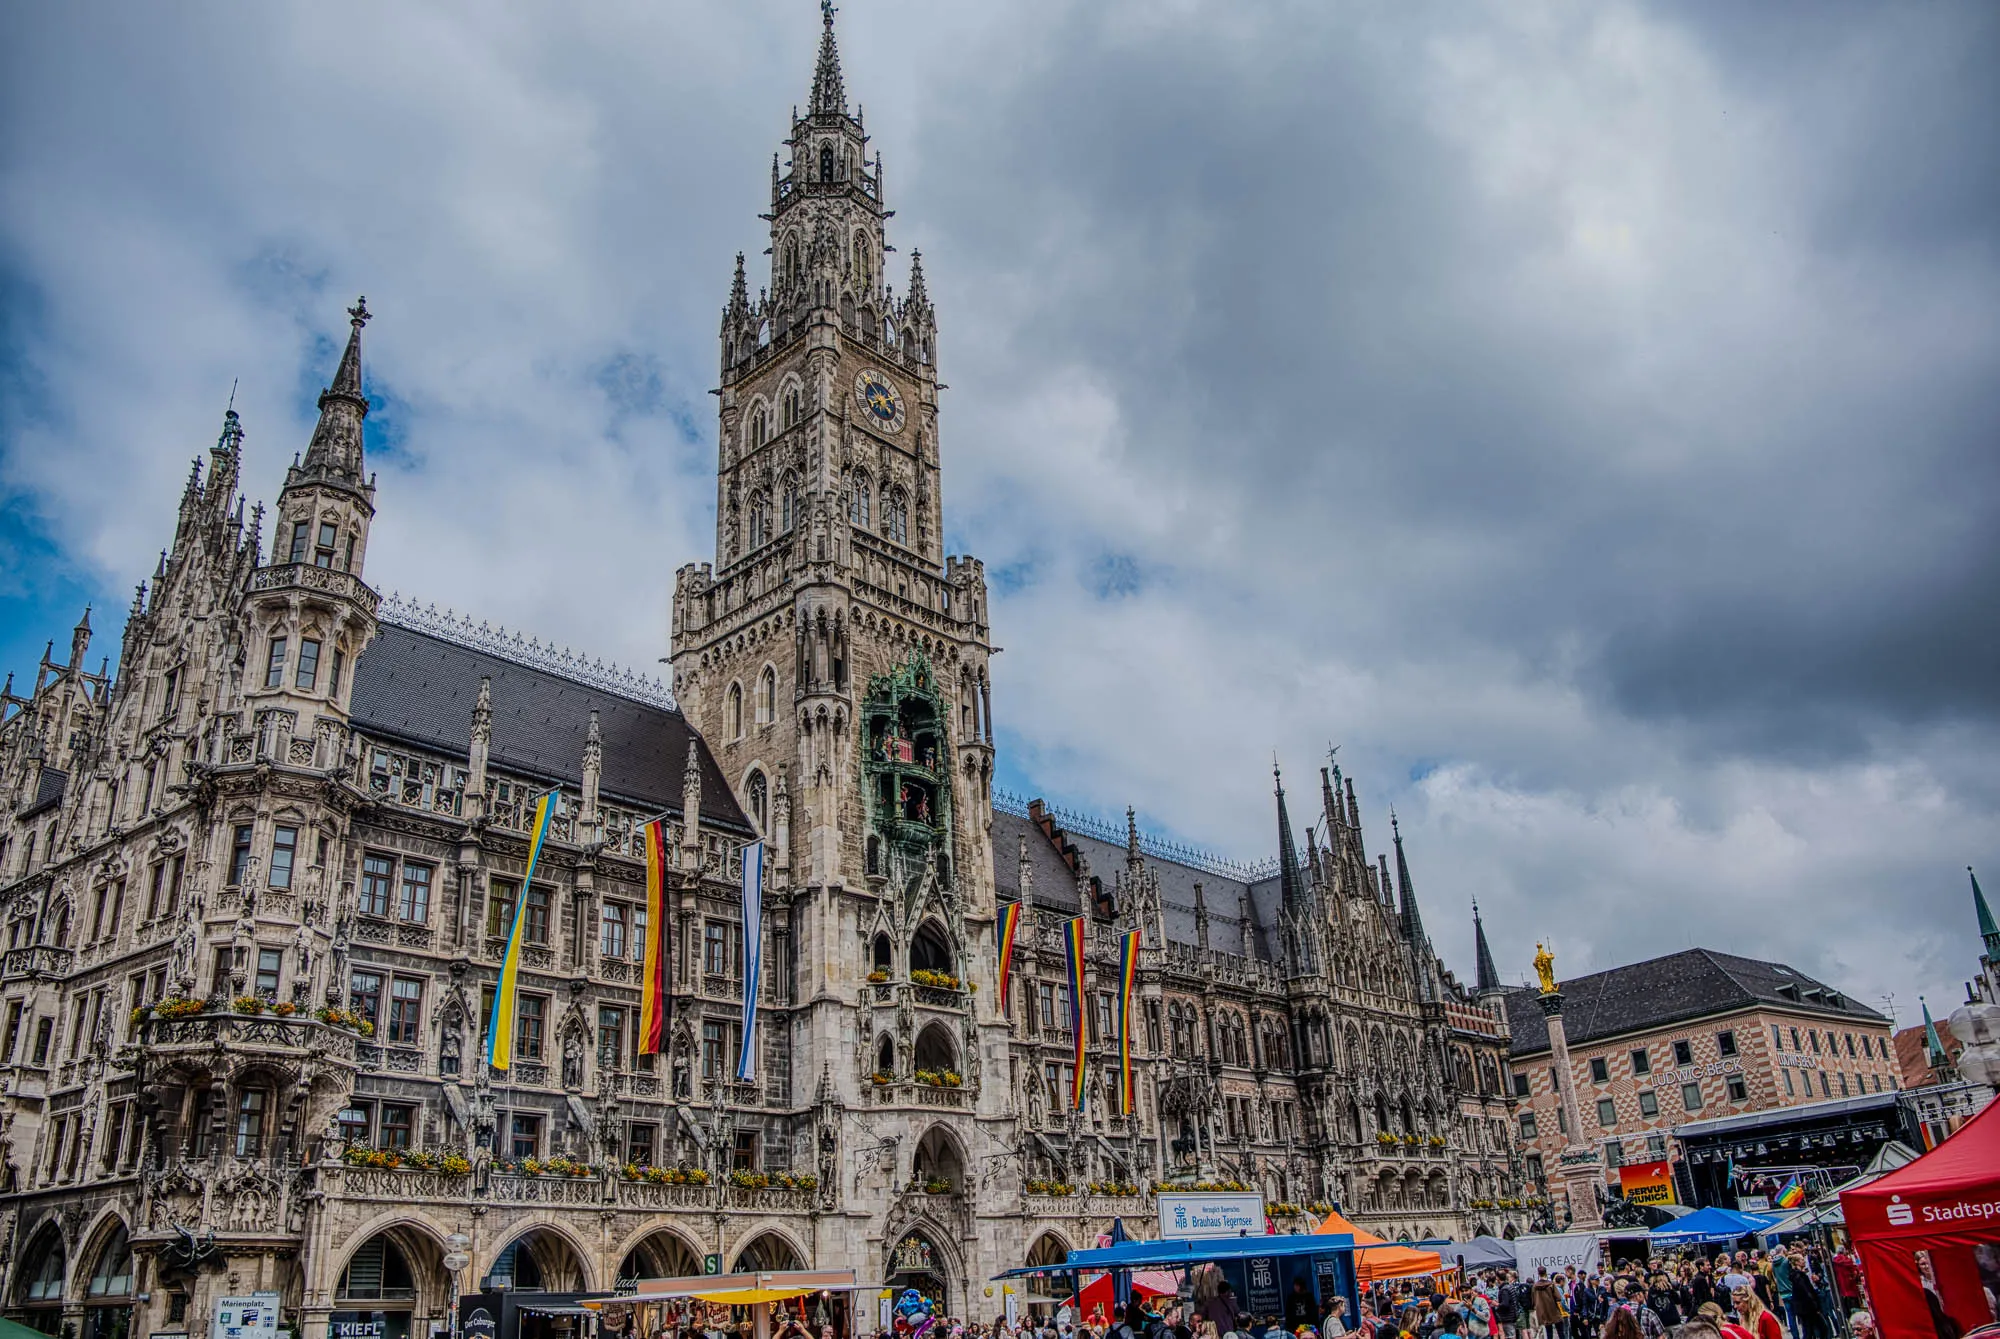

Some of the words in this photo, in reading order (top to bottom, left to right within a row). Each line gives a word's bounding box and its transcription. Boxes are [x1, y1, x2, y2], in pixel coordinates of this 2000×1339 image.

[1776, 1053, 1801, 1067] LUDWIG
[1801, 1056, 1817, 1069] BECK
[1650, 1065, 1704, 1087] LUDWIG
[1706, 1057, 1744, 1077] BECK
[1627, 1184, 1668, 1196] SERVUS
[1192, 1216, 1221, 1228] Brauhaus
[1222, 1215, 1253, 1229] Tegernsee
[706, 1256, 716, 1274] S
[1530, 1254, 1583, 1268] INCREASE
[221, 1300, 265, 1308] Marienplatz
[340, 1322, 381, 1336] KIEFL
